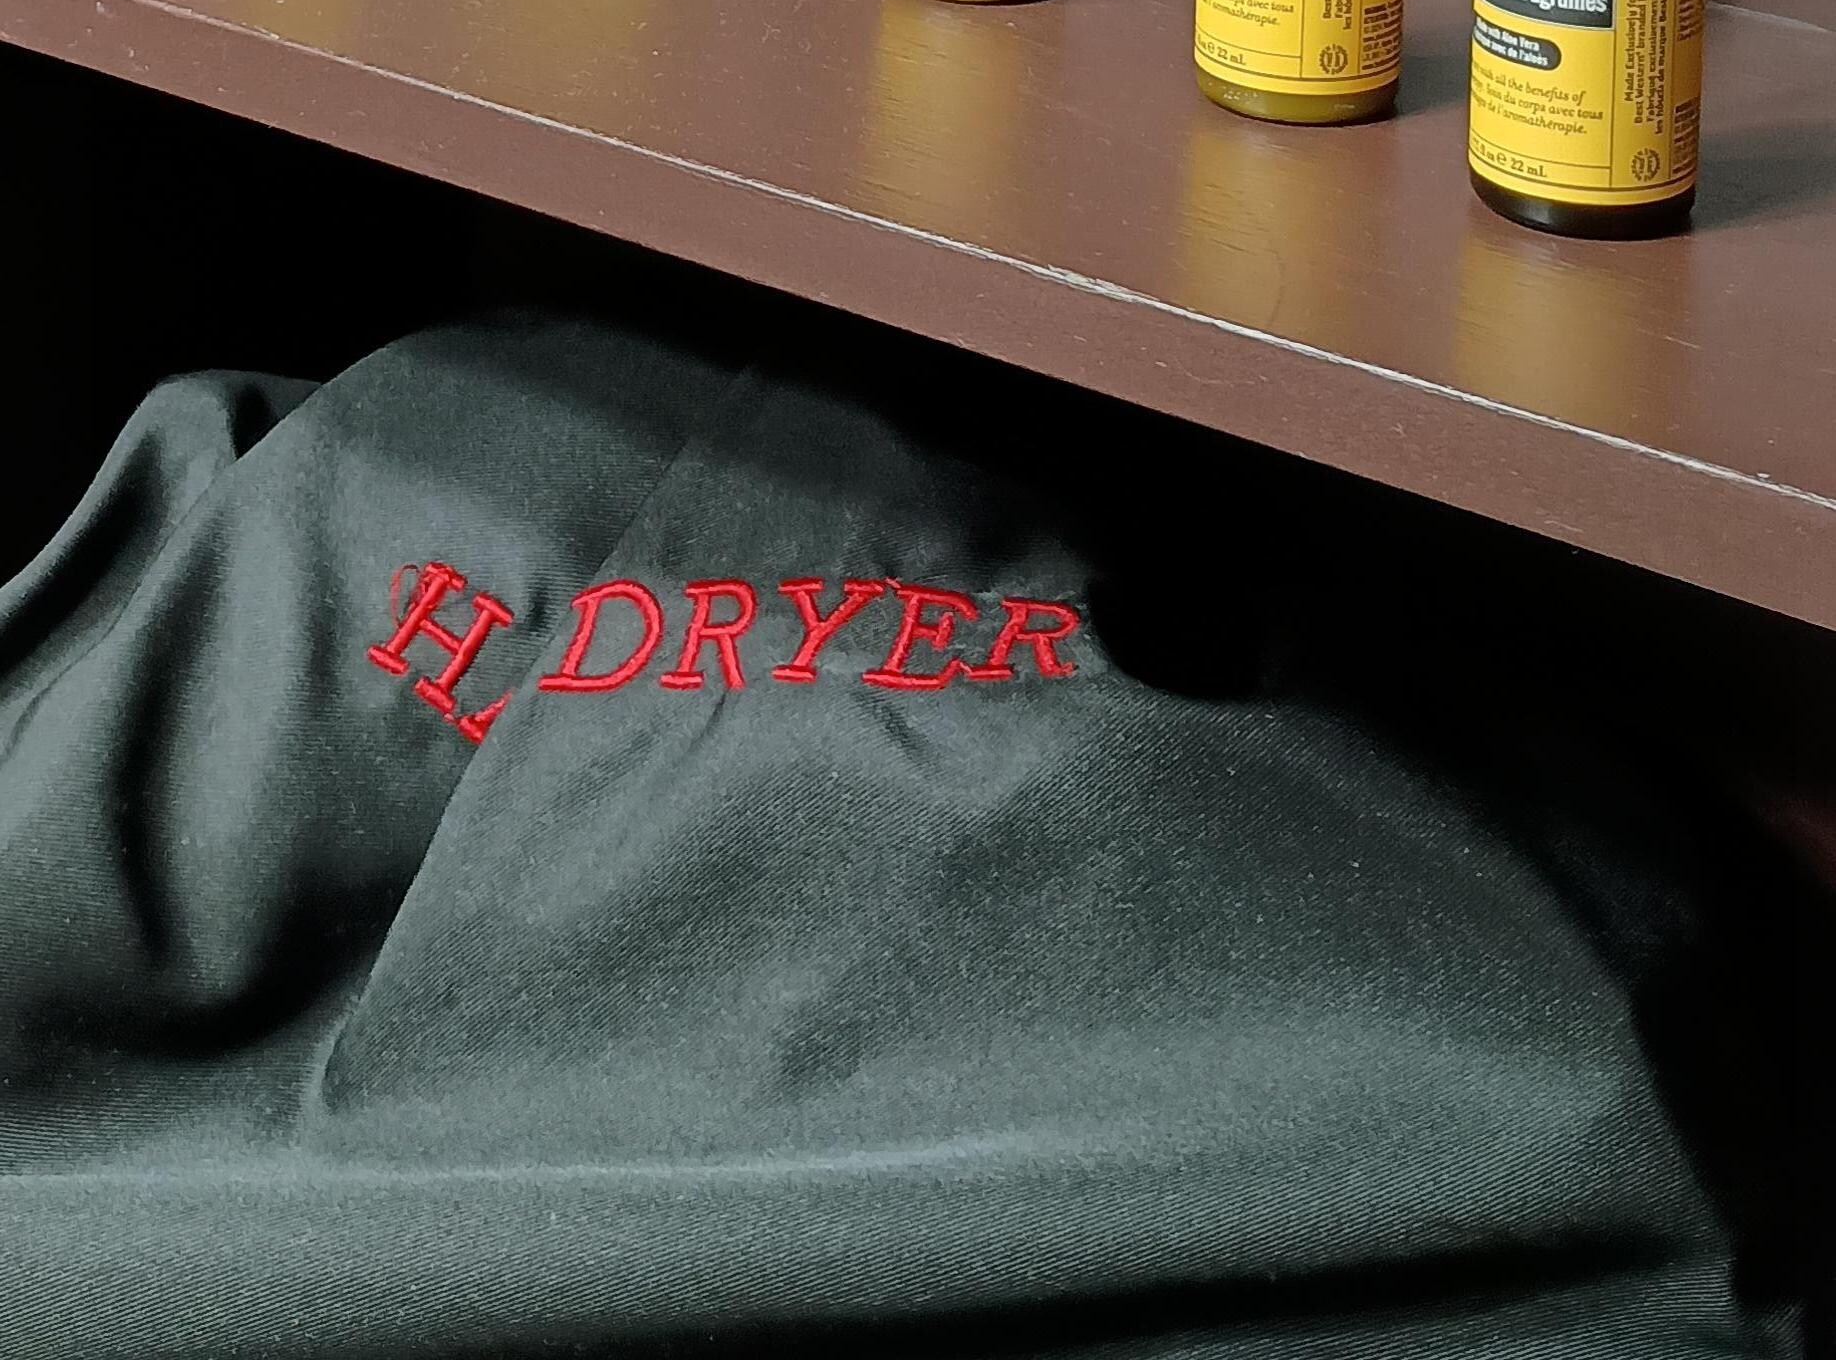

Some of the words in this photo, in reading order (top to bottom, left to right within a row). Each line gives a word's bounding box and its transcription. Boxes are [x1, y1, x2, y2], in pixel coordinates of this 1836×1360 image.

[1625, 9, 1636, 70] Exclusively
[1636, 3, 1647, 49] branded
[1215, 46, 1229, 61] 22
[1658, 25, 1668, 67] marque
[1624, 72, 1635, 102] Made
[1635, 51, 1645, 99] Western
[1503, 90, 1517, 106] du
[1517, 96, 1546, 116] corps
[1548, 104, 1577, 119] avec
[1576, 108, 1604, 122] tous
[1507, 76, 1524, 92] the
[1525, 81, 1569, 103] benefits
[1571, 90, 1587, 107] of
[1634, 99, 1644, 124] Best
[1509, 155, 1526, 174] 22
[1526, 164, 1549, 179] mL
[366, 561, 513, 745] H
[537, 577, 1081, 692] DRYER
